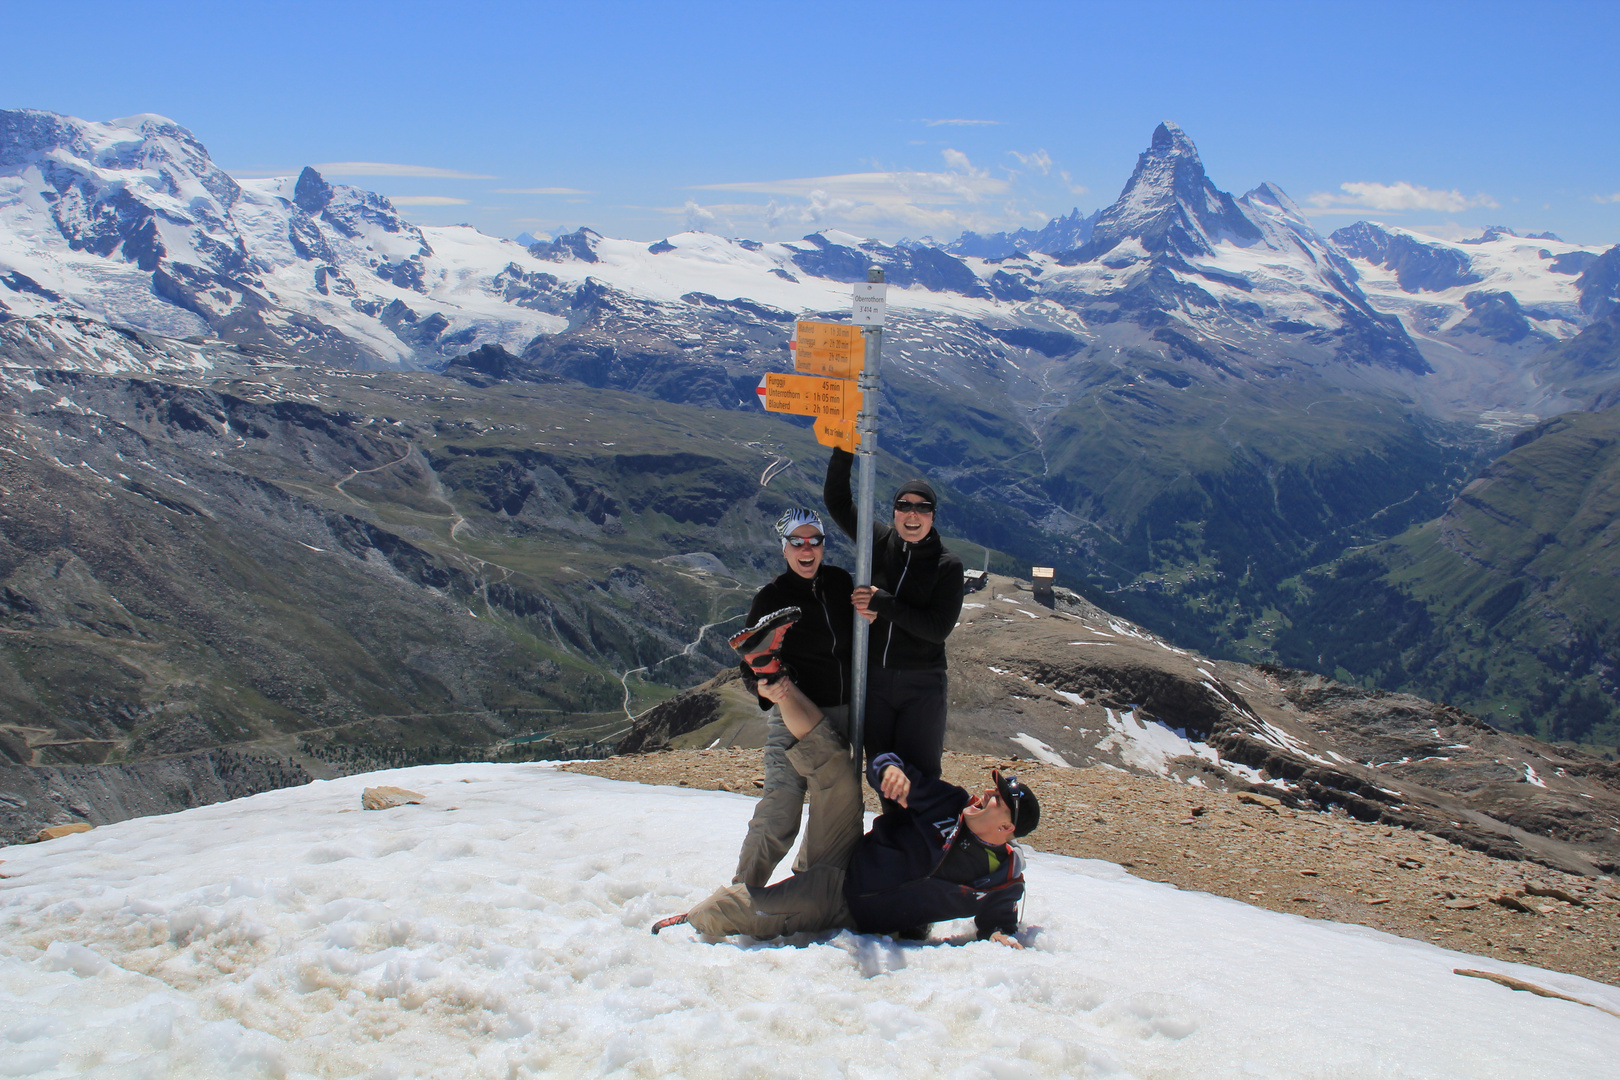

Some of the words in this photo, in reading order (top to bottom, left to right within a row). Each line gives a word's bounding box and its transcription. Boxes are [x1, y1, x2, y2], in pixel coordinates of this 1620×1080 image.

[822, 382, 829, 390] 45
[830, 382, 840, 391] min
[769, 388, 800, 400] Unterrothorn
[822, 393, 829, 402] 05
[830, 394, 840, 403] min
[769, 399, 790, 410] Blauherd
[823, 406, 829, 414] 10
[830, 406, 840, 415] min
